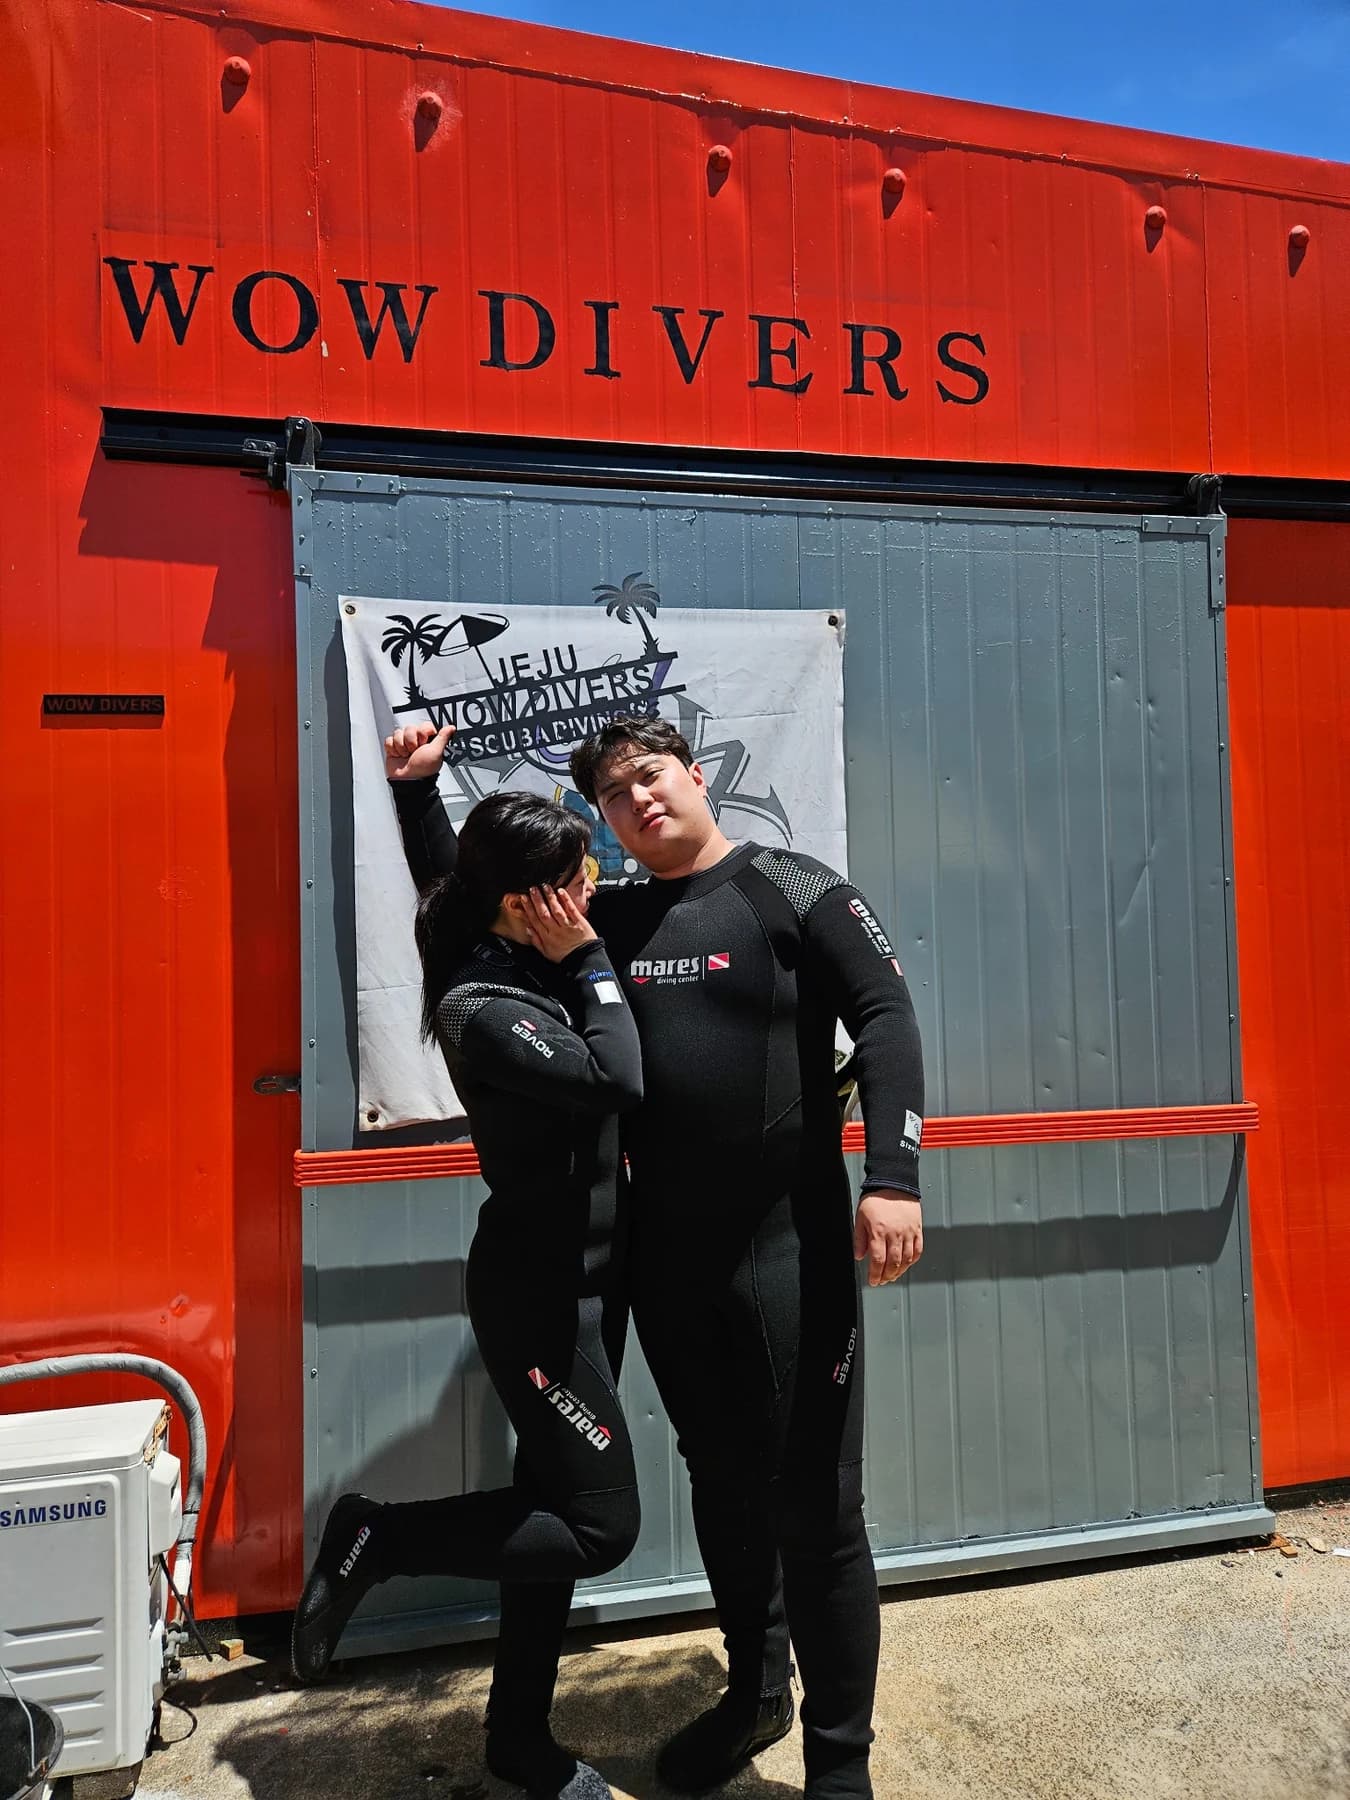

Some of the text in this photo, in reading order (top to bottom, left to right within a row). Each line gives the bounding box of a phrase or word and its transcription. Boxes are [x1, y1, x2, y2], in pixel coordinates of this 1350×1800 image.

[103, 256, 989, 404] WOW DIVERS
[494, 644, 578, 686] JEJU
[46, 698, 162, 712] WOW DIVERS
[427, 665, 655, 732] WOW DIVERS
[468, 724, 550, 757] SCUBA
[851, 898, 893, 954] mares
[630, 956, 700, 977] mares
[656, 975, 699, 986] diving center
[511, 1023, 554, 1059] ROVER
[836, 1327, 857, 1385] ROVER
[548, 1390, 610, 1451] mares
[0, 1499, 107, 1527] SAMSUNG
[339, 1526, 371, 1578] mares
